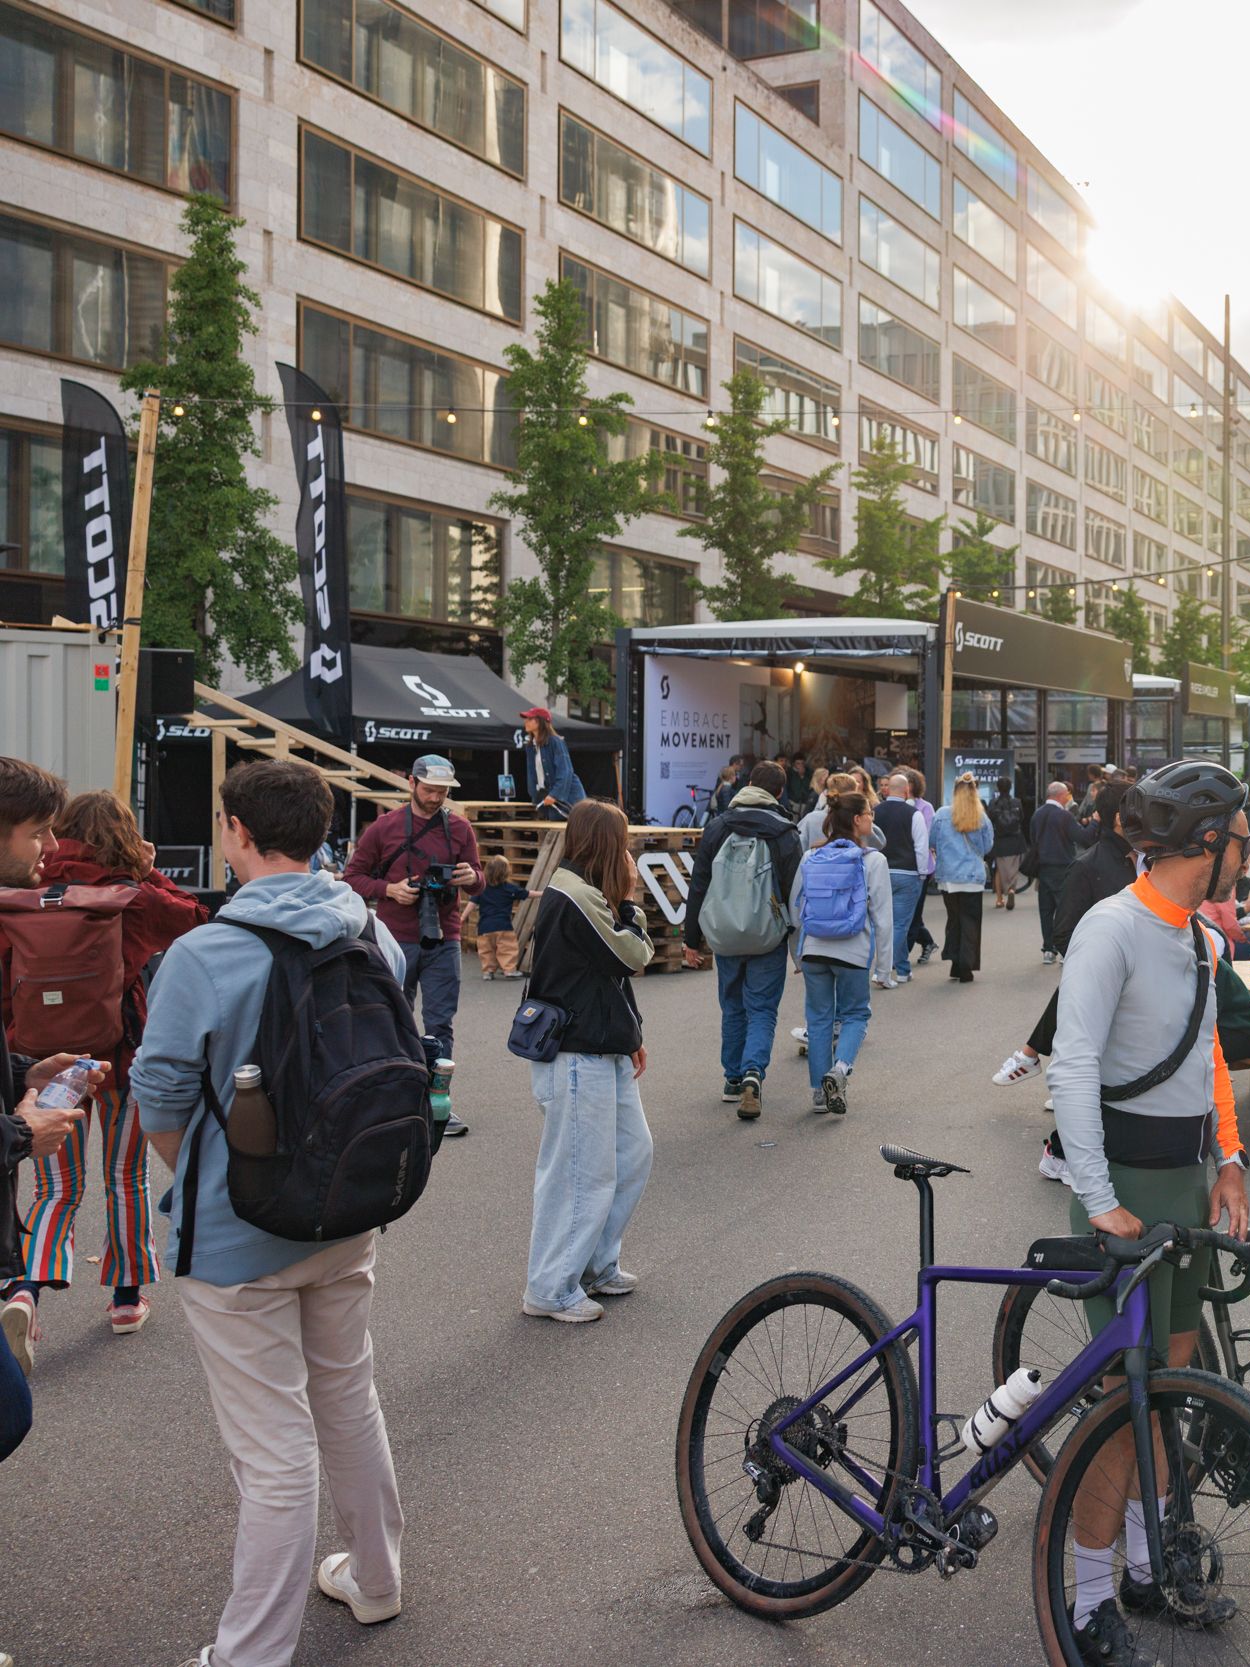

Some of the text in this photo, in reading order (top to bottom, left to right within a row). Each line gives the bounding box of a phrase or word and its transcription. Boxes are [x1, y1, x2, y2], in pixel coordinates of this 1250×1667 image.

[82, 436, 118, 630] SCOTT
[307, 424, 331, 631] SCOTT
[964, 631, 1004, 652] SCOTT
[421, 707, 491, 719] SCOTT
[660, 709, 729, 729] EMBRACE
[166, 725, 212, 738] SCO
[377, 726, 432, 741] SCOTT
[660, 731, 731, 749] MOVEMENT
